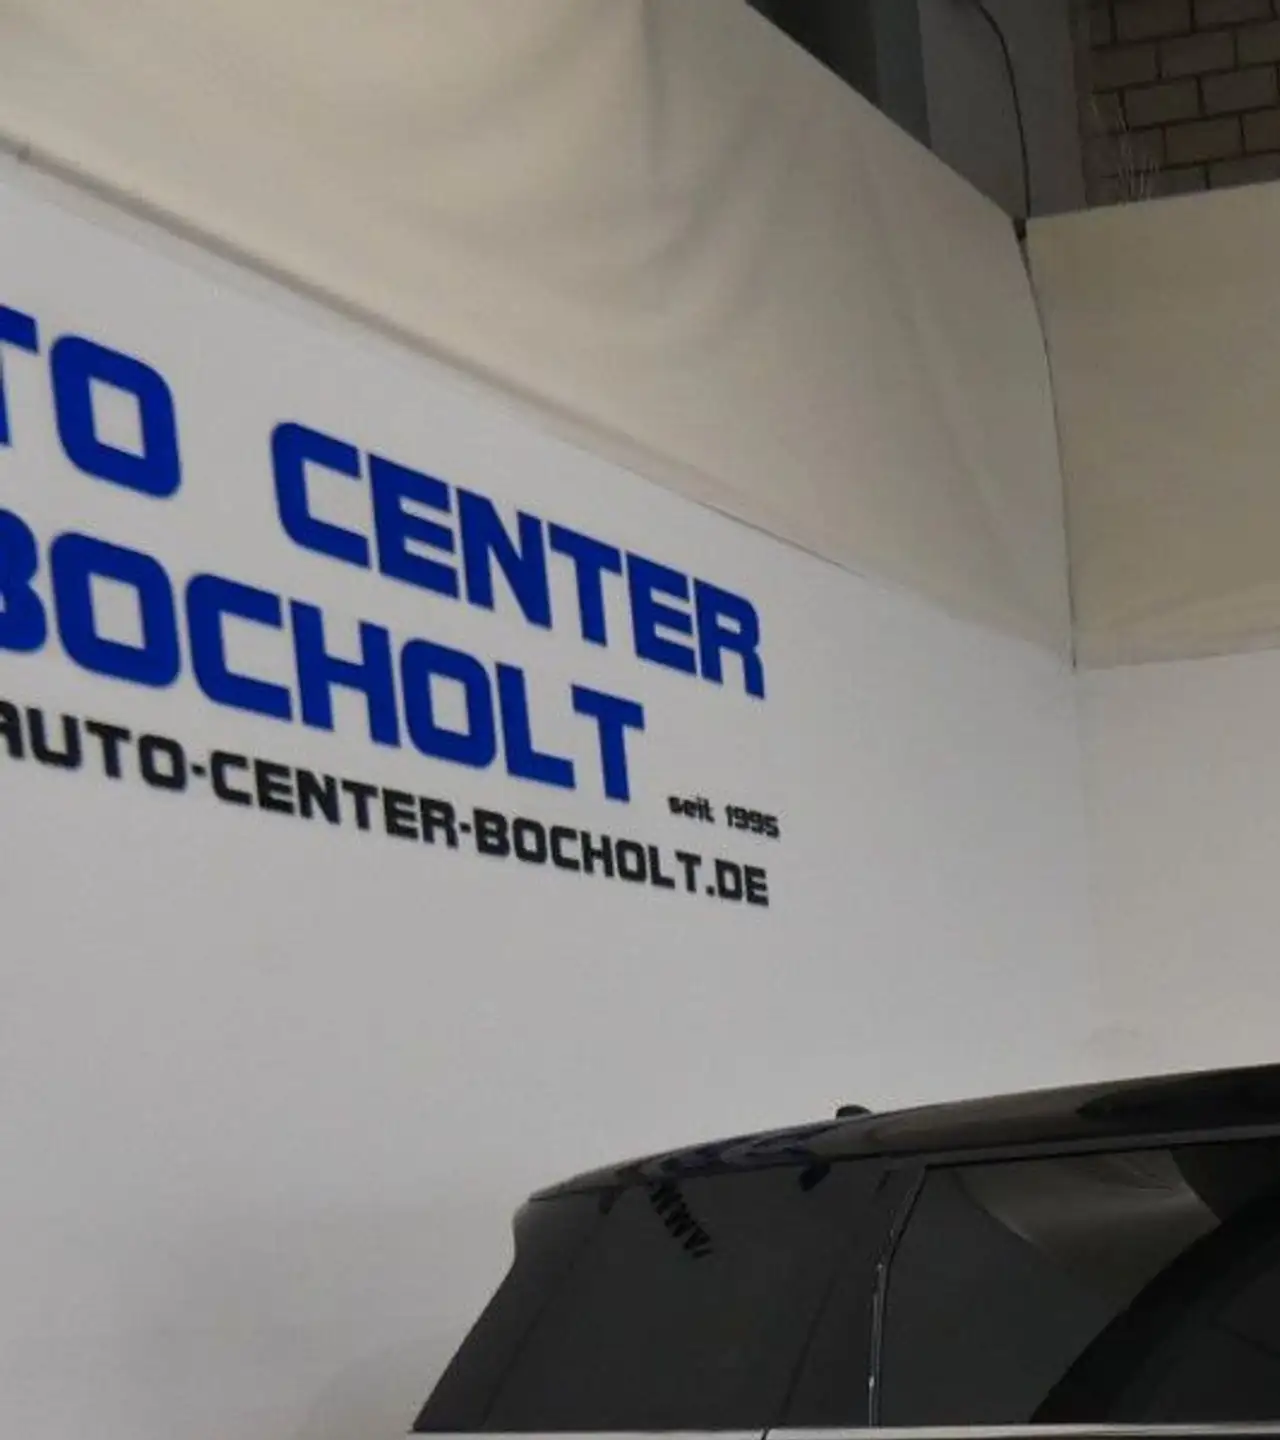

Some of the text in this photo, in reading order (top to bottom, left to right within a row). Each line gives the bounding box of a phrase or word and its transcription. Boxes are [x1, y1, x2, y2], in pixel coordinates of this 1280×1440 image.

[270, 421, 766, 700] CENTER
[667, 795, 715, 823] seit
[724, 804, 780, 840] 1995
